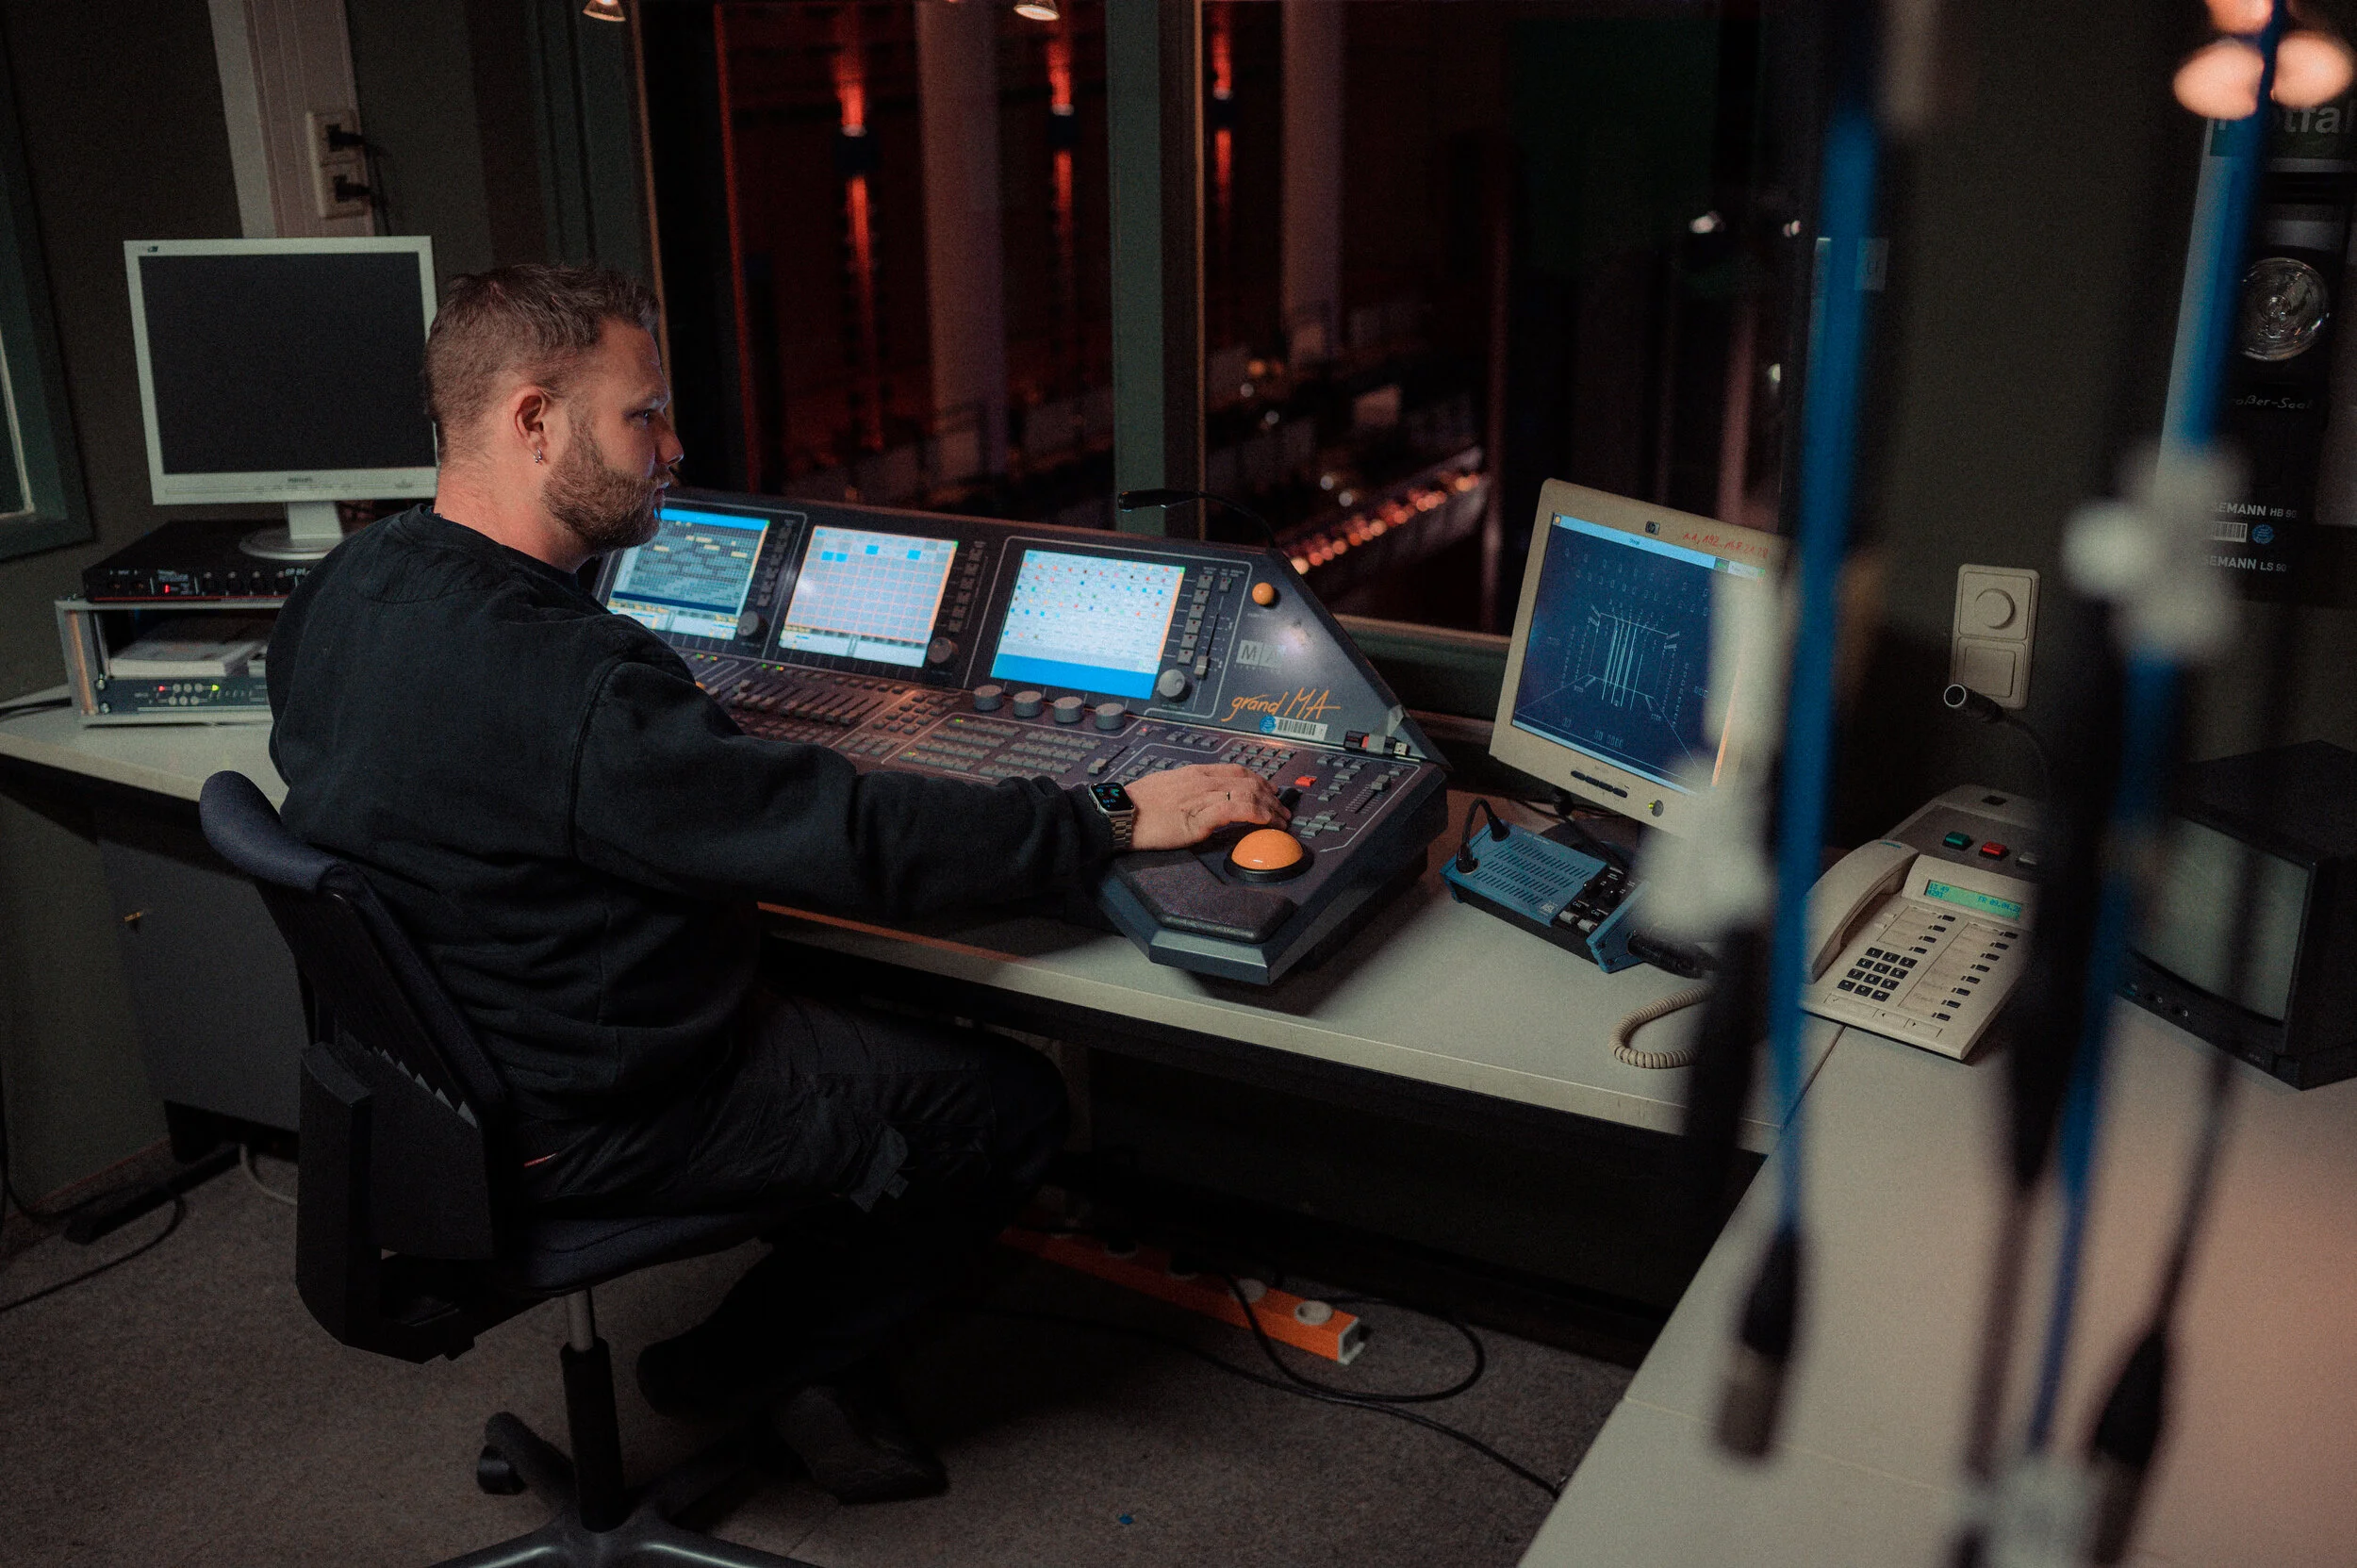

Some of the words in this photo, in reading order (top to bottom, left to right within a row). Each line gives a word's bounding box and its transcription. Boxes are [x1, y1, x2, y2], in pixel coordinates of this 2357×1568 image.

[2269, 507, 2283, 518] HB
[2260, 561, 2274, 571] LS
[1221, 691, 1289, 723] grand
[1283, 687, 1342, 720] MA
